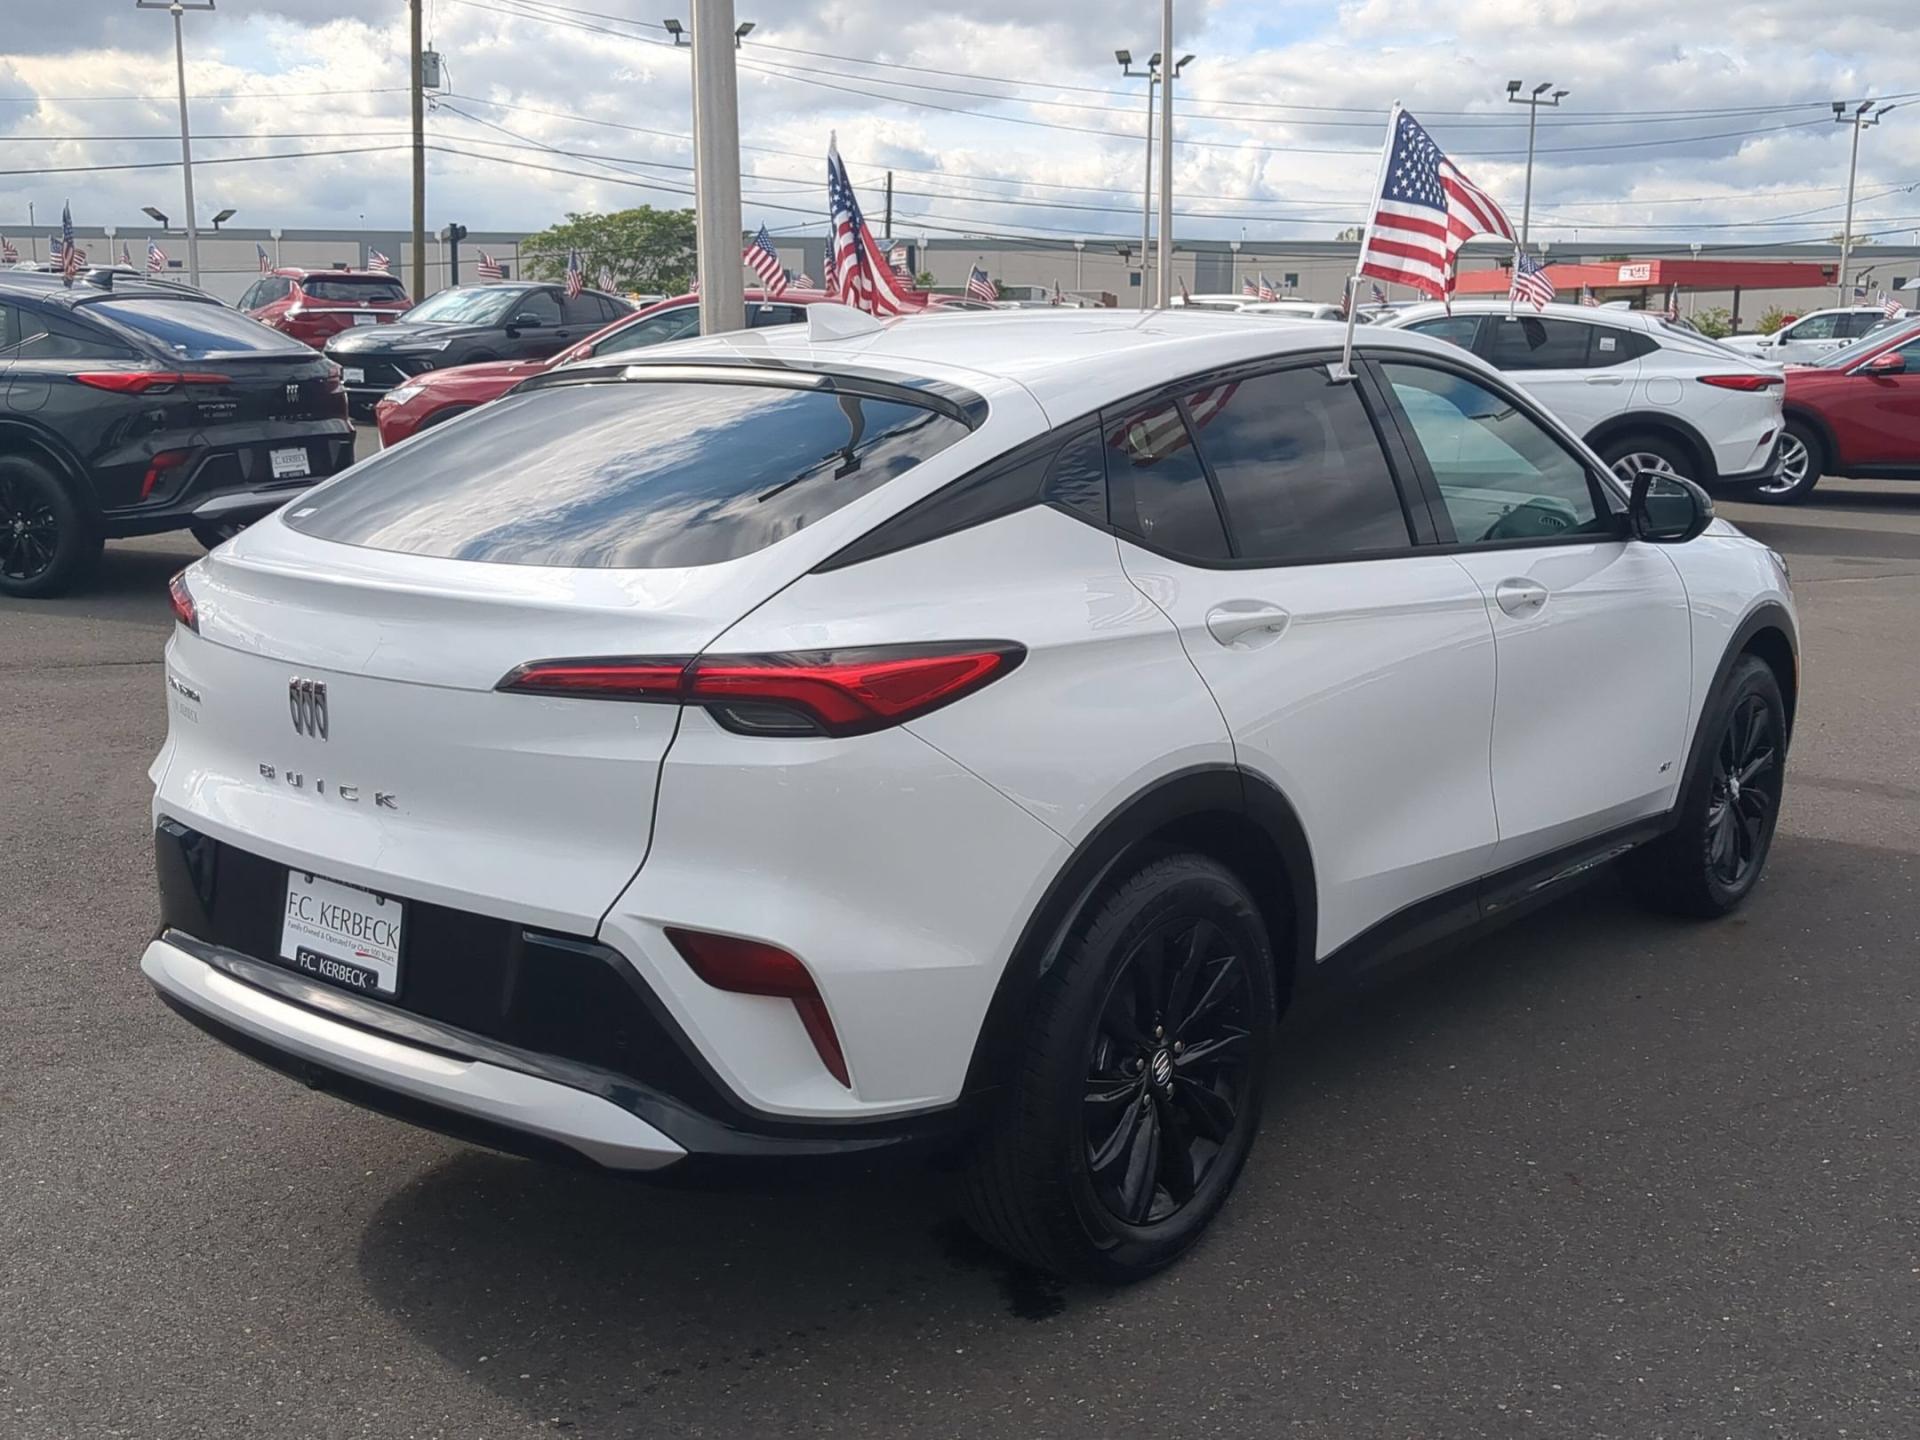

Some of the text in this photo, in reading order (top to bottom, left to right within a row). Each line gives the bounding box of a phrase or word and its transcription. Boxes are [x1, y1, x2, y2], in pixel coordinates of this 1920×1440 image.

[259, 762, 398, 809] BUICK
[287, 891, 399, 950] F.C. KERBECK
[300, 951, 368, 989] F.C. KERBECK
